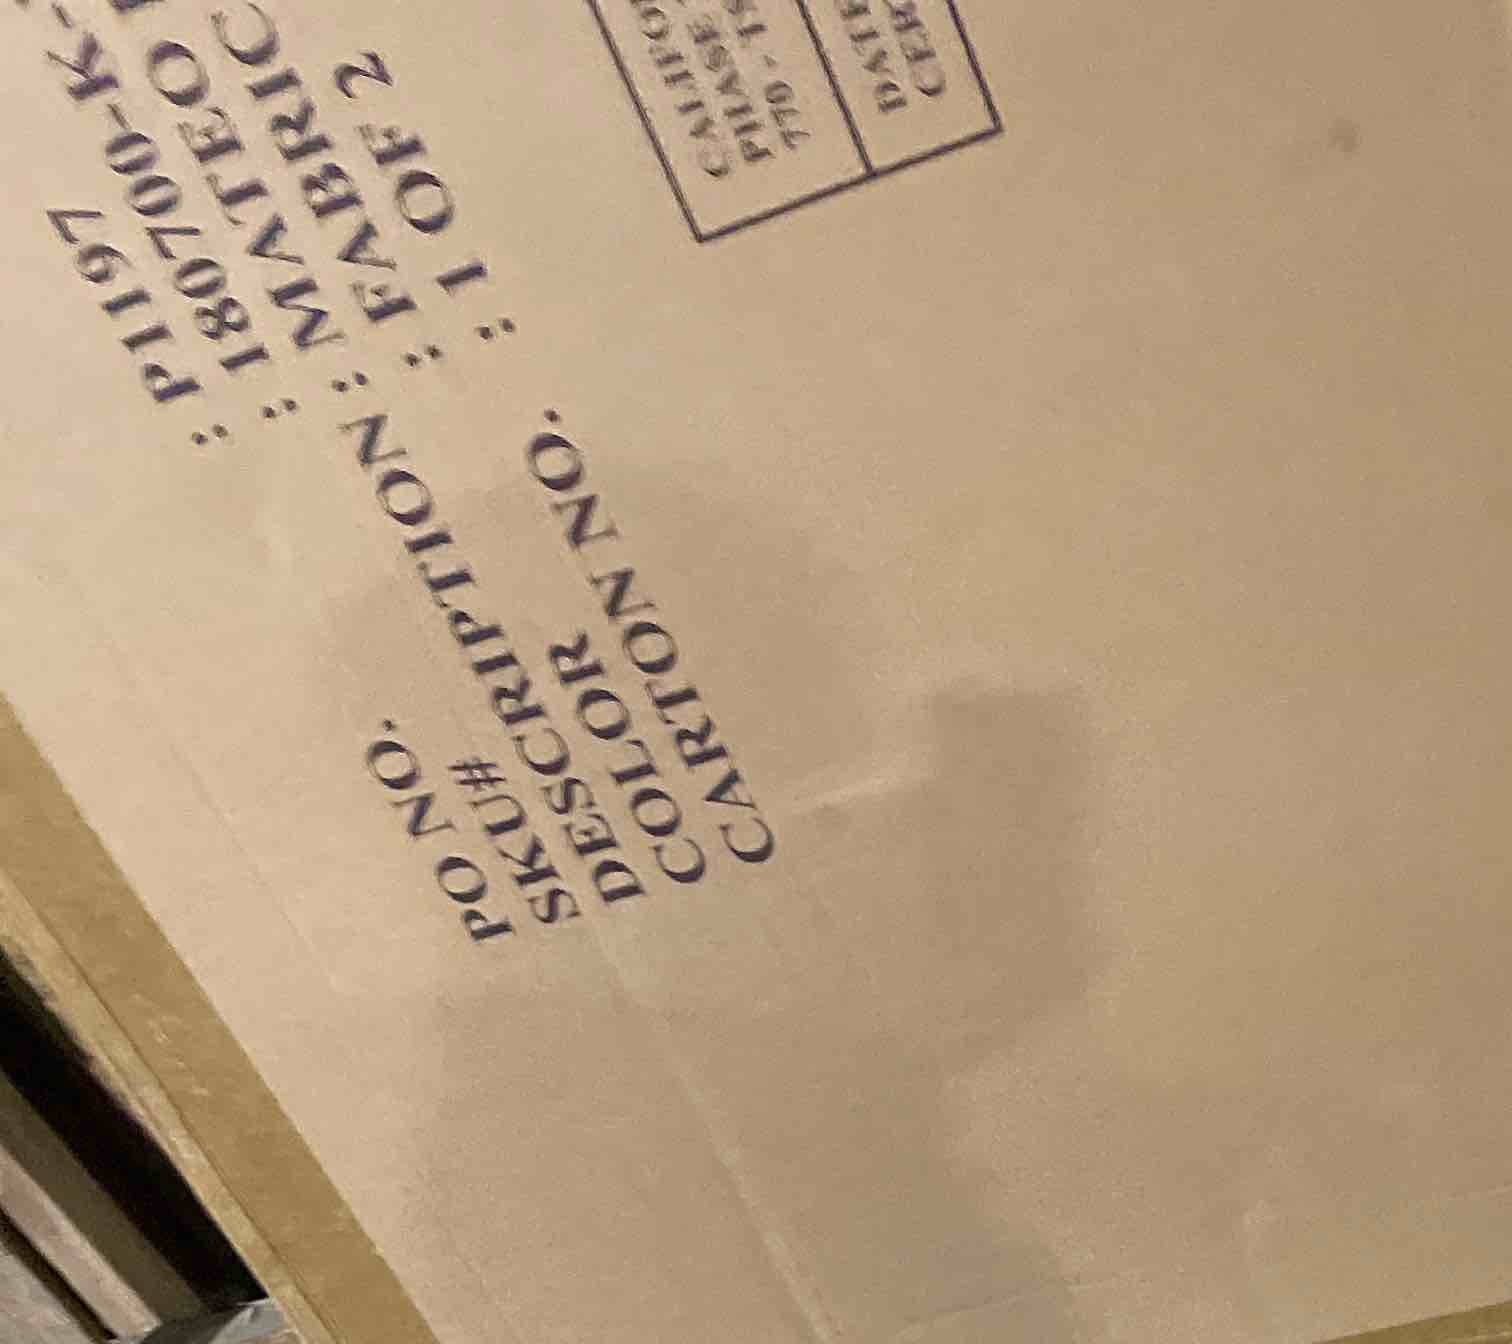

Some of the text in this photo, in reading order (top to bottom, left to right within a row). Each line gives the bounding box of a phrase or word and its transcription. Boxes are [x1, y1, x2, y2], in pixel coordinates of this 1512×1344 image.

[210, 0, 418, 323] FABRIC
[333, 49, 393, 99] 2
[629, 0, 732, 177] CALIFO
[14, 0, 270, 371] 180700-K-
[146, 40, 346, 350] MATEO
[352, 121, 456, 235] OF
[47, 208, 204, 402] P1197
[435, 255, 488, 295] 1
[526, 407, 620, 551] NO.
[336, 413, 647, 904] DESCRIPTION
[587, 566, 775, 864] CARTON
[364, 718, 458, 841] NO.
[448, 756, 581, 925] SKU#
[548, 630, 705, 885] COLOR
[434, 855, 517, 943] PO
